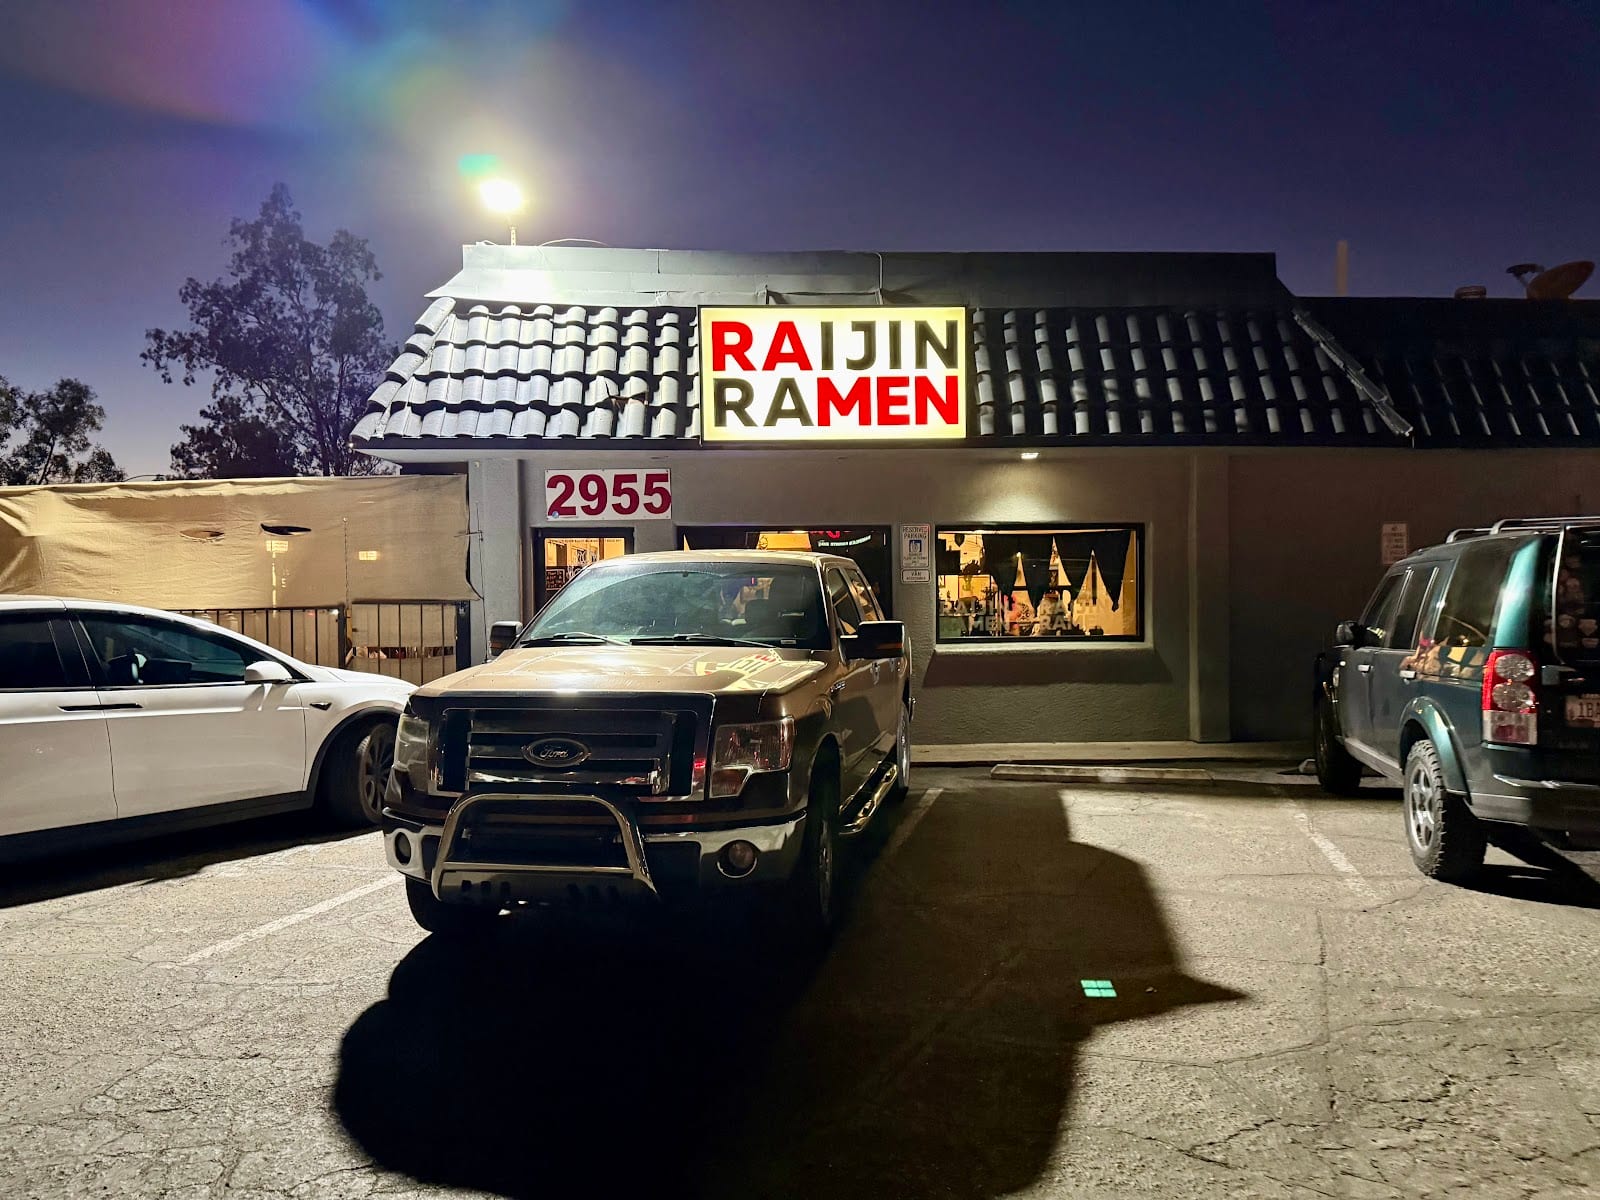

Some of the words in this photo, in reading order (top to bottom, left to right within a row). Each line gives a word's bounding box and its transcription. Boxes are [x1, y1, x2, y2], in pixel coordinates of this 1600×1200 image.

[711, 319, 959, 372] RAIJIN
[712, 375, 959, 427] RAMEN
[546, 473, 672, 516] 2955
[540, 745, 569, 759] Ford
